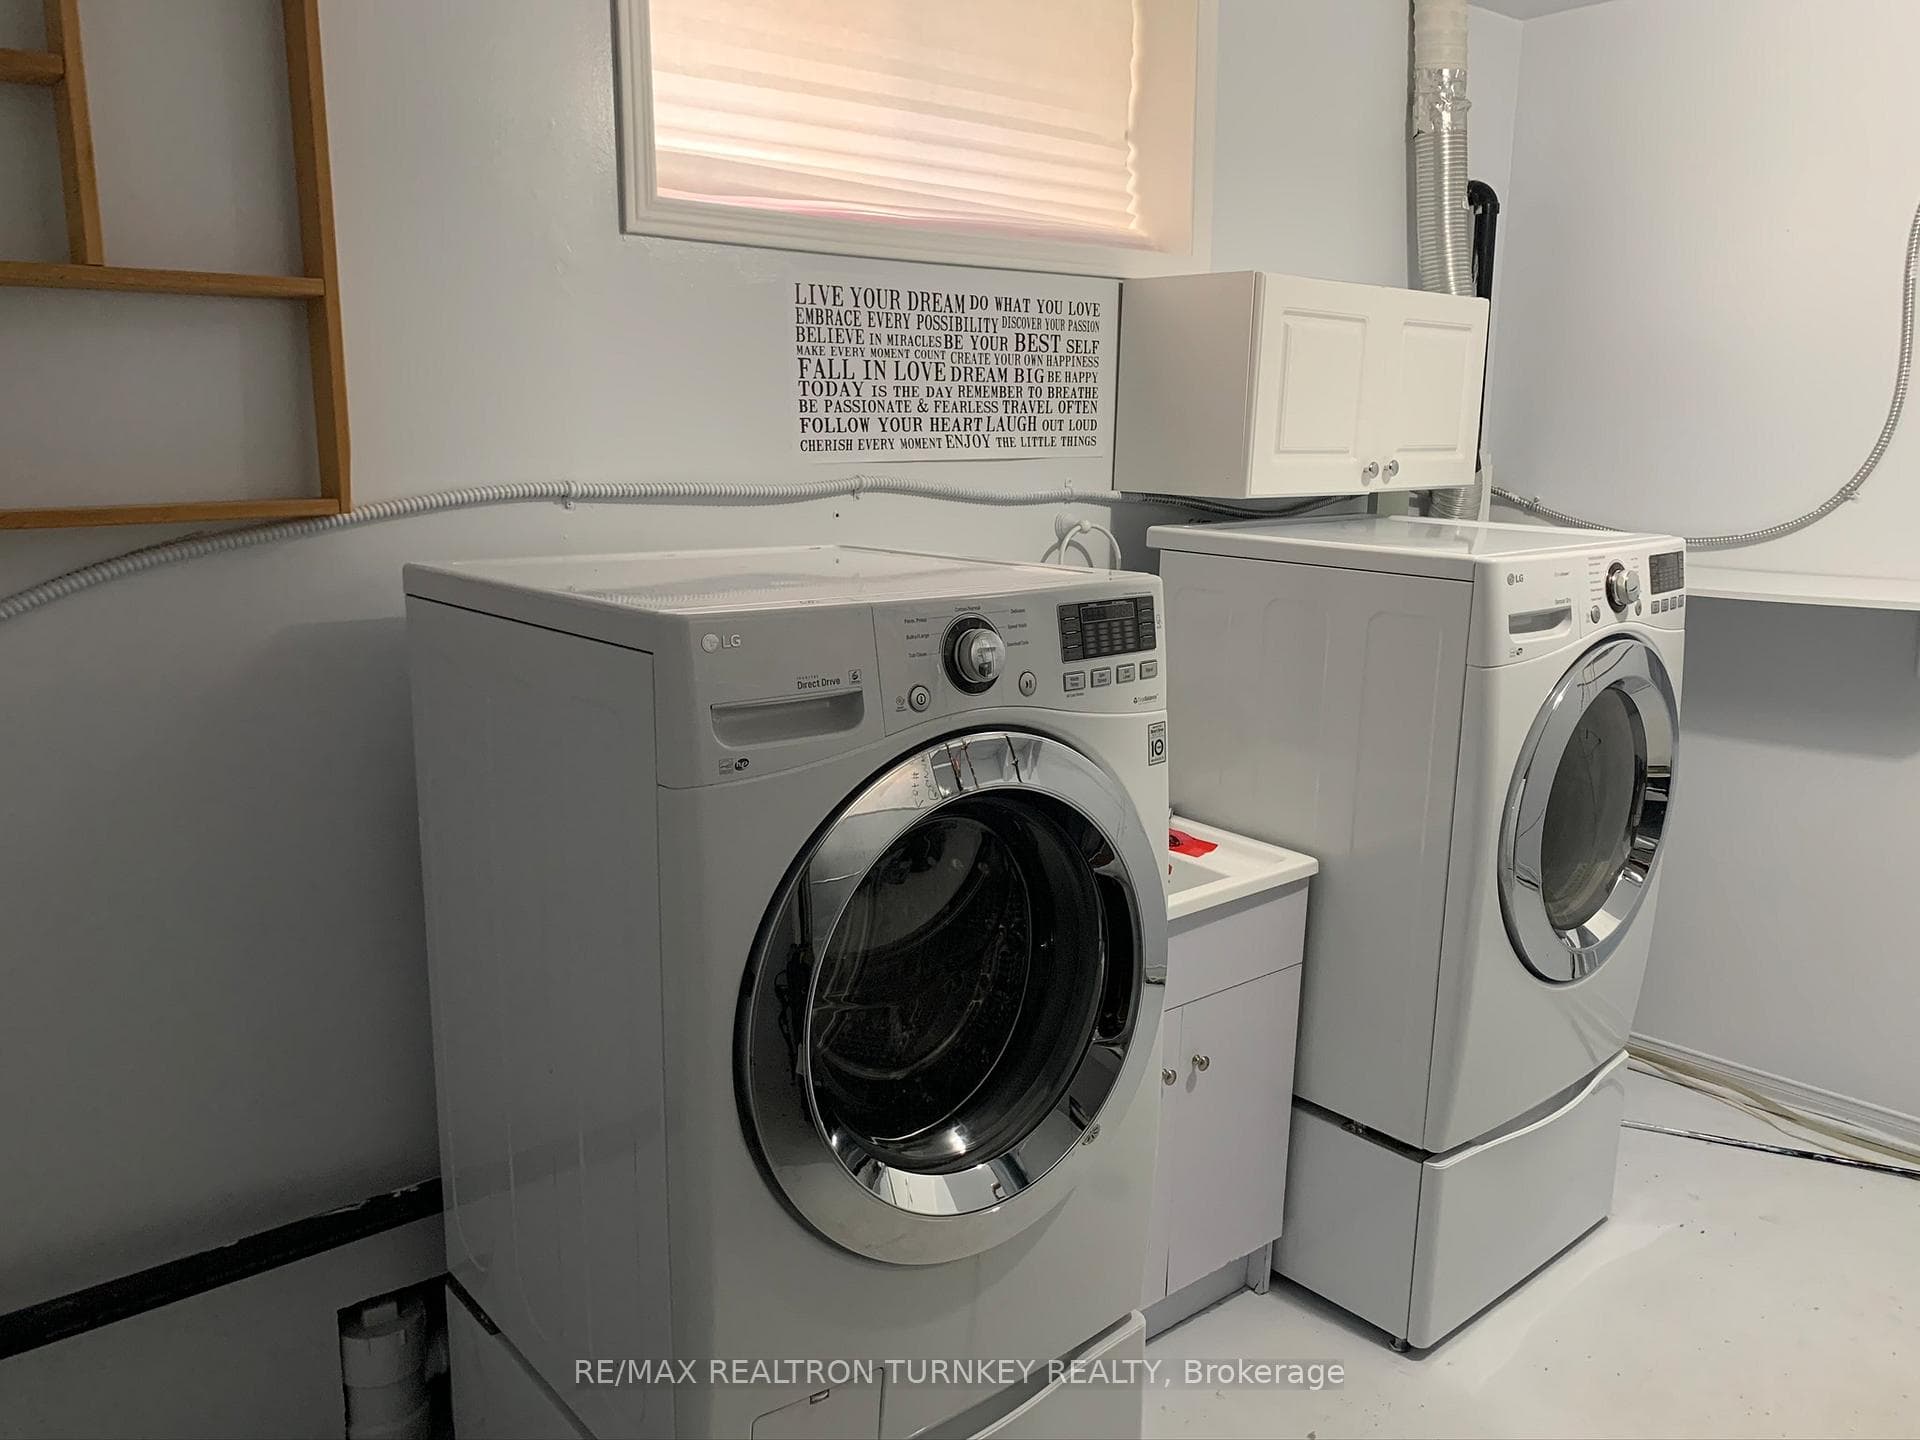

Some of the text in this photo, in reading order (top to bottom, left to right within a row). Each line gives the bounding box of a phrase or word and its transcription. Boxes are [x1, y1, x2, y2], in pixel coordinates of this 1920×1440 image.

[795, 283, 1100, 317] LIVE YOUR DREAM DO WHAT YOU LOVE
[796, 307, 1099, 334] EMBRACE EVERY POSSIBILITY DISCOVER YOUR PASSION
[796, 326, 1099, 354] BELIEVE IN MIRACLES BE YOUR BEST SELF
[796, 345, 1099, 367] MAKE EVERY MOMENT COUNT CREATE YOUR OWN HAPPINESS
[798, 358, 1098, 383] FALL IN LOVE DREAM BIG BE HAPPY
[798, 381, 1098, 399] TODAY IS THE DAY REMEMBER TO BREATHE
[799, 398, 1097, 414] BE PASSIONATE & FEARLESS TRAVEL OFTEN
[800, 416, 1097, 433] FOLLOW YOUR HEART LAUGH OUT LOUD
[800, 434, 1096, 451] CHERISH EVERY MOMENT ENJOY THE LITTLE THINGS
[1516, 575, 1523, 583] LG
[722, 634, 741, 648] LG
[797, 677, 841, 690] Direct Drive
